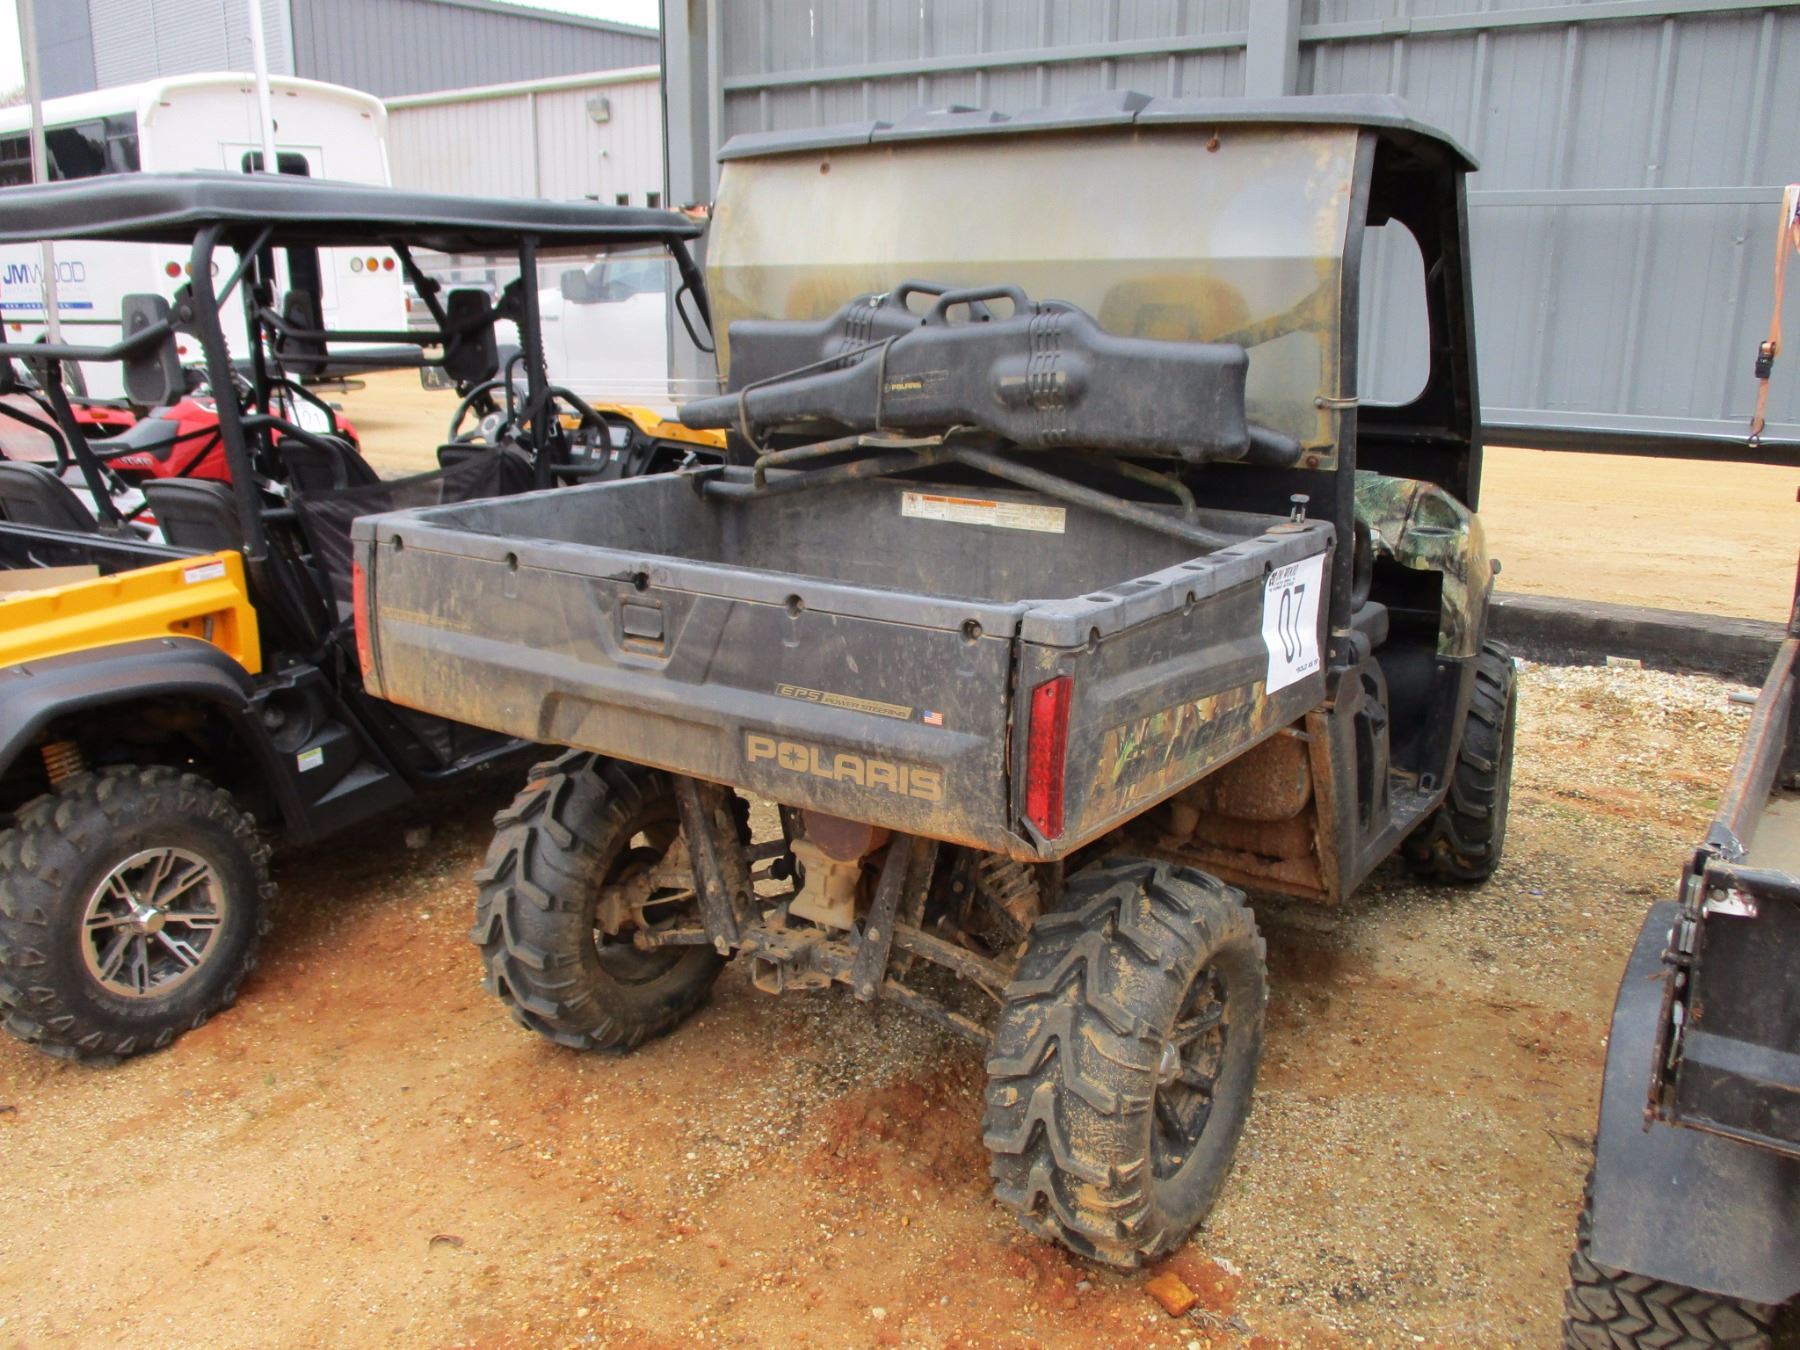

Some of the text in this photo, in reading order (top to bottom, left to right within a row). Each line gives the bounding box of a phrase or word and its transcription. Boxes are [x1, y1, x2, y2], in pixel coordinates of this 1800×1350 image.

[781, 686, 821, 701] EPS
[825, 698, 860, 709] POWER
[747, 735, 942, 801] POLARIS
